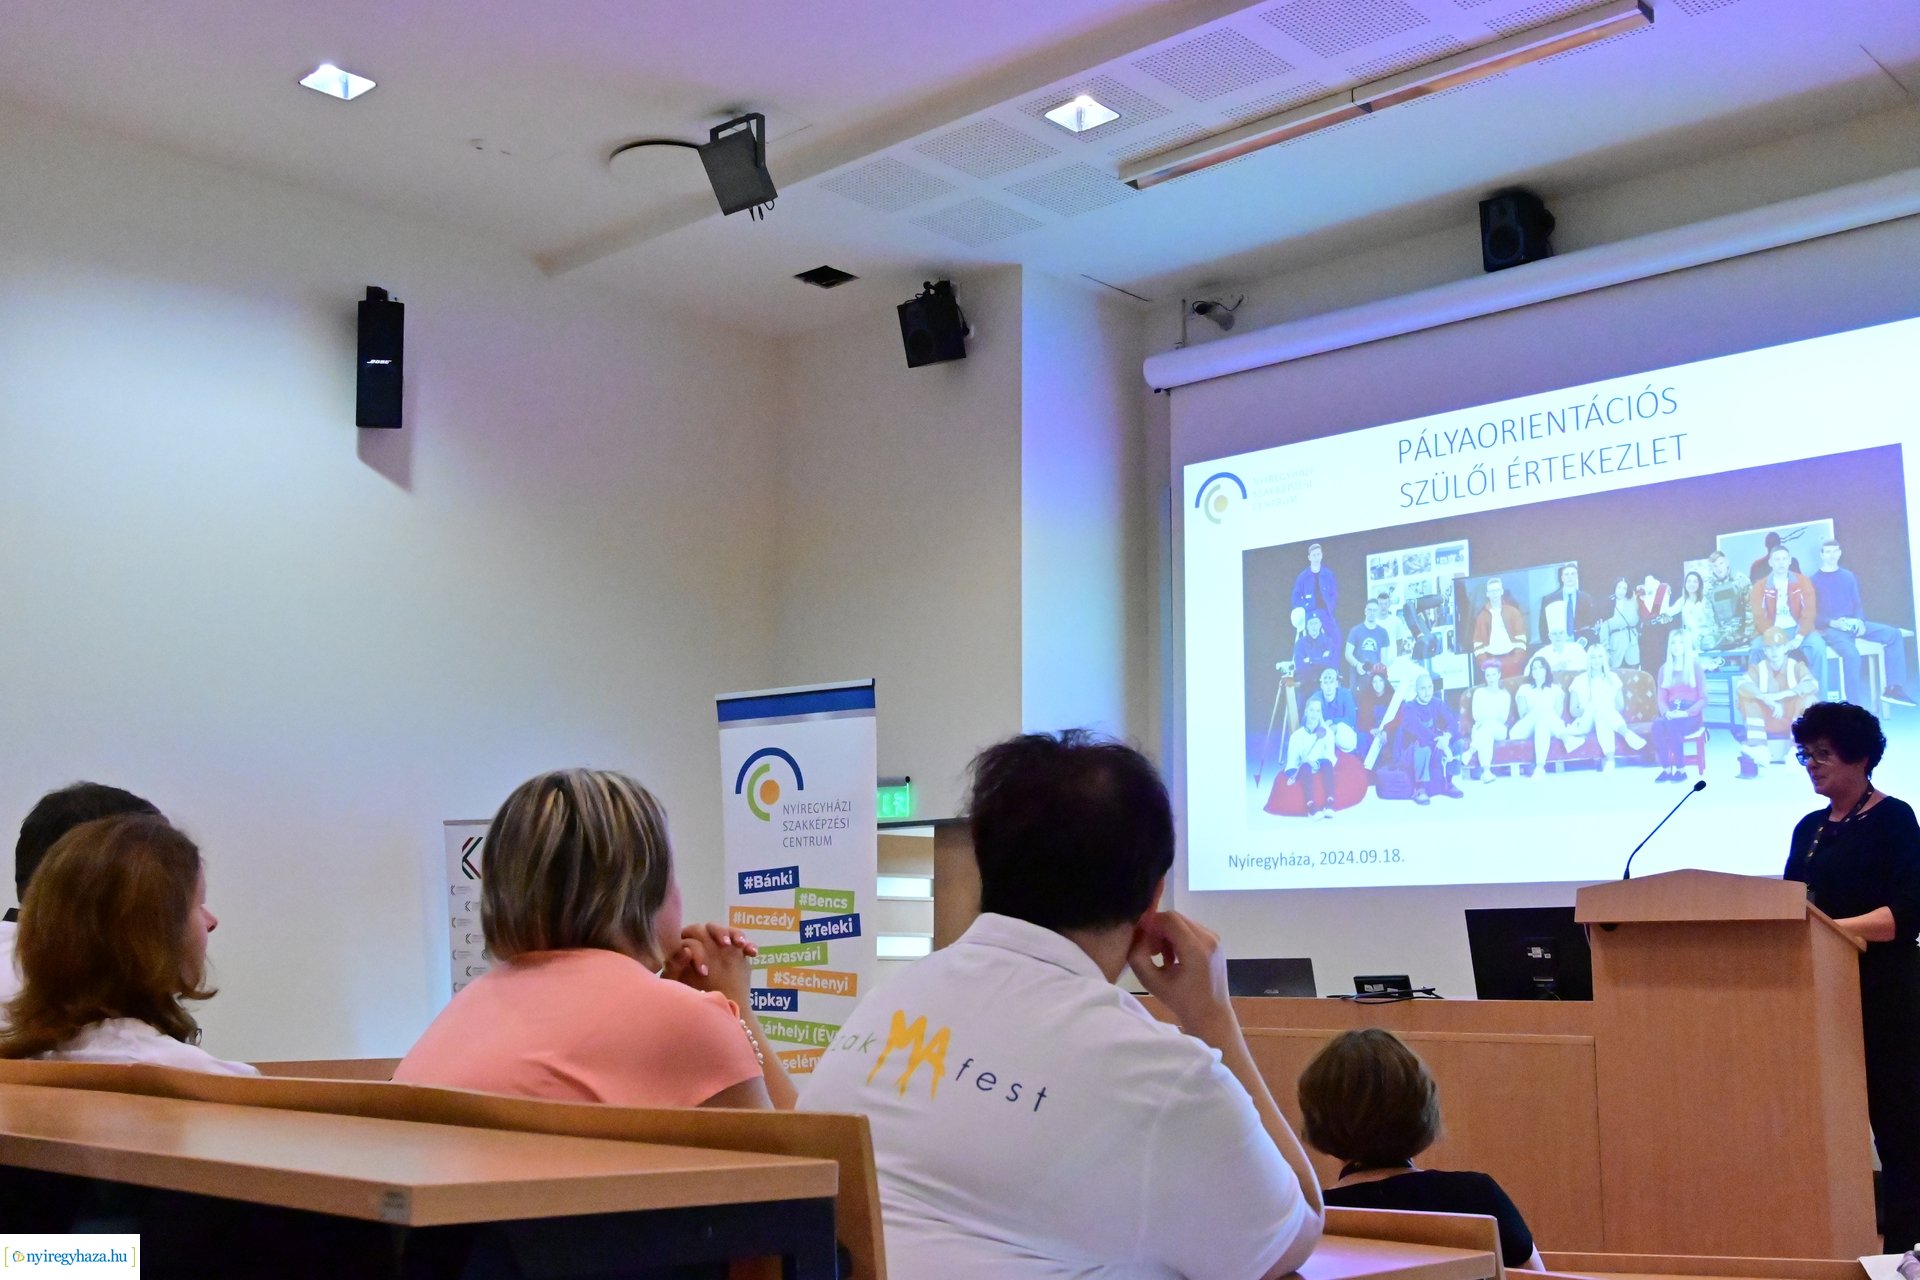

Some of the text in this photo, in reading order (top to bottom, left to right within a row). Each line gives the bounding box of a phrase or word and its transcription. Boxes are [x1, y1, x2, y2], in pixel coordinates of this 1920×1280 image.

[1398, 383, 1678, 464] PÁLYAORIENTÁCIÓS
[1400, 432, 1689, 508] SZÜLŐI ÉRTEKEZLET
[782, 799, 851, 815] NYÍREGYHÁZI
[782, 816, 850, 832] SZAKKÉPZÉSI
[782, 835, 833, 848] CENTRUM
[1228, 848, 1405, 871] Nyíregyháza, 2024.09.18.
[743, 870, 793, 889] #Bánki
[799, 893, 848, 909] #Bencs
[733, 911, 795, 930] #Inczédy
[804, 918, 853, 938] #Teleki
[773, 970, 848, 991] #Széchenyi
[761, 1020, 809, 1041] árhelyi
[955, 1058, 1048, 1112] fest
